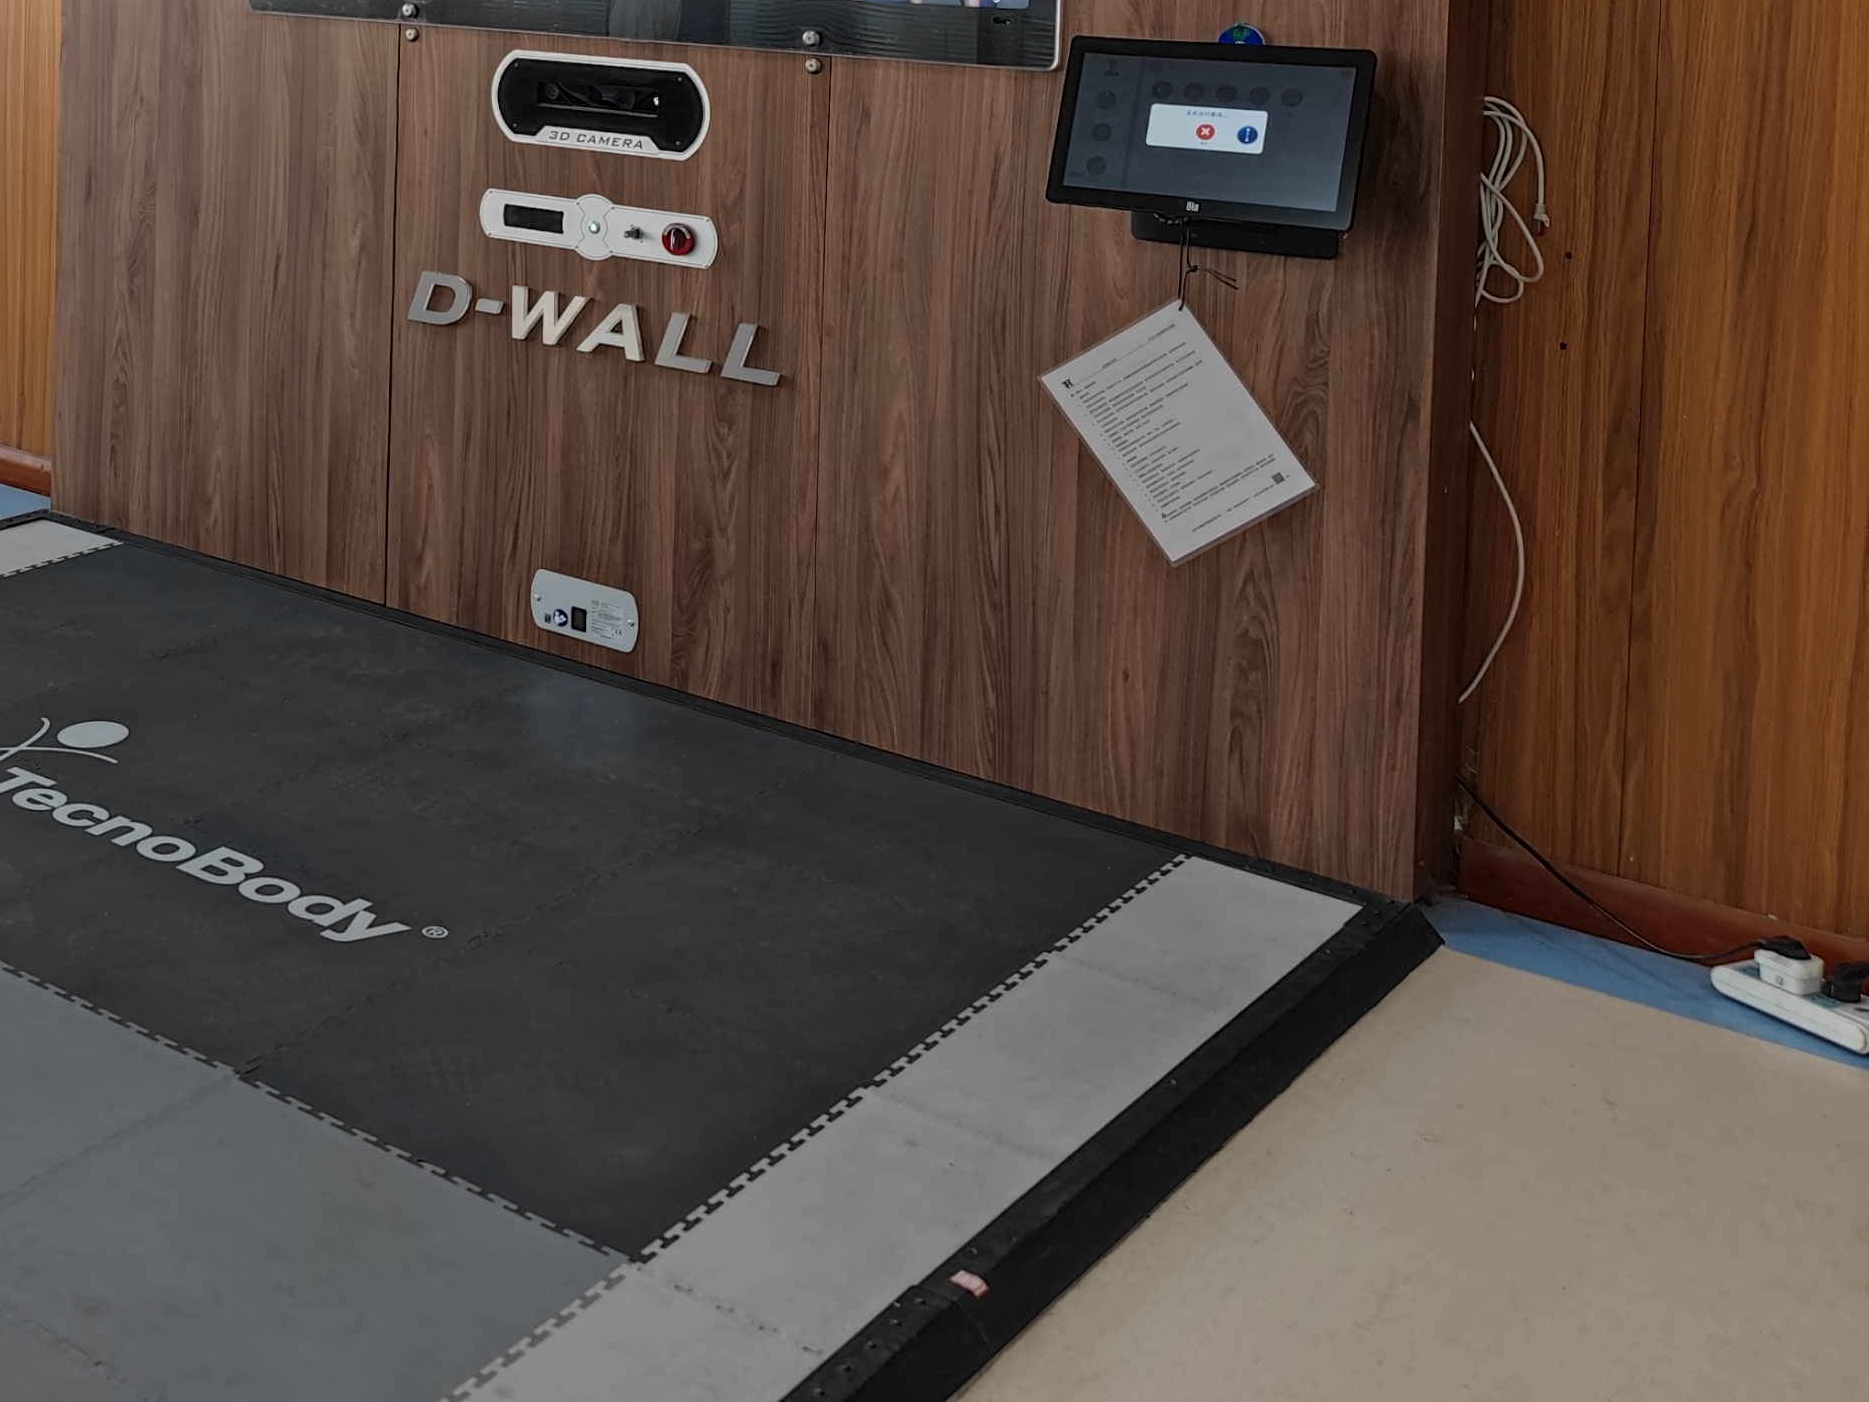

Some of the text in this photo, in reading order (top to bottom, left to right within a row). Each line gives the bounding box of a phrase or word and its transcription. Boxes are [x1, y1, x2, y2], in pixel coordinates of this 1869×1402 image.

[549, 130, 643, 150] 3D CAMERA
[407, 270, 782, 386] D-WALL
